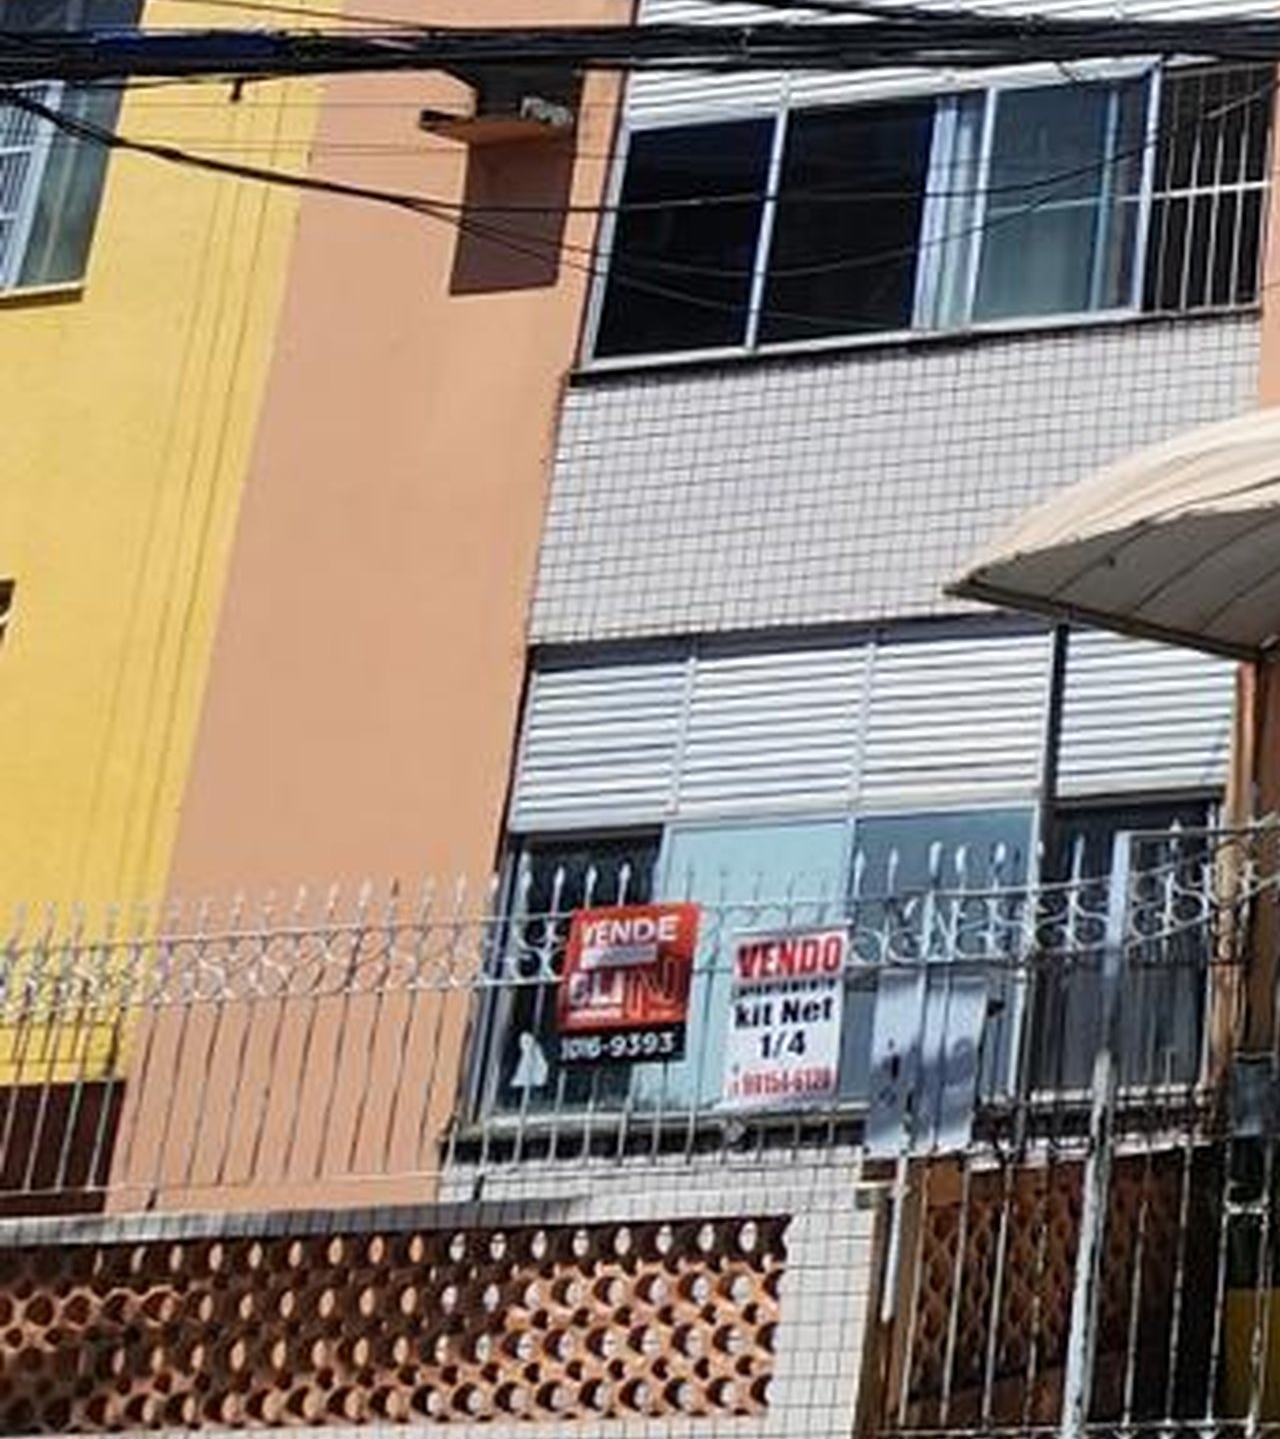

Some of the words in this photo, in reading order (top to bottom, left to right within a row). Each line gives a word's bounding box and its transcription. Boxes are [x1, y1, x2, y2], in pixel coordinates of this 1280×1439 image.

[581, 915, 680, 947] VENDE
[737, 936, 843, 978] VENDO
[734, 1002, 772, 1028] kit
[781, 996, 833, 1024] Net
[760, 1030, 806, 1059] 1/4
